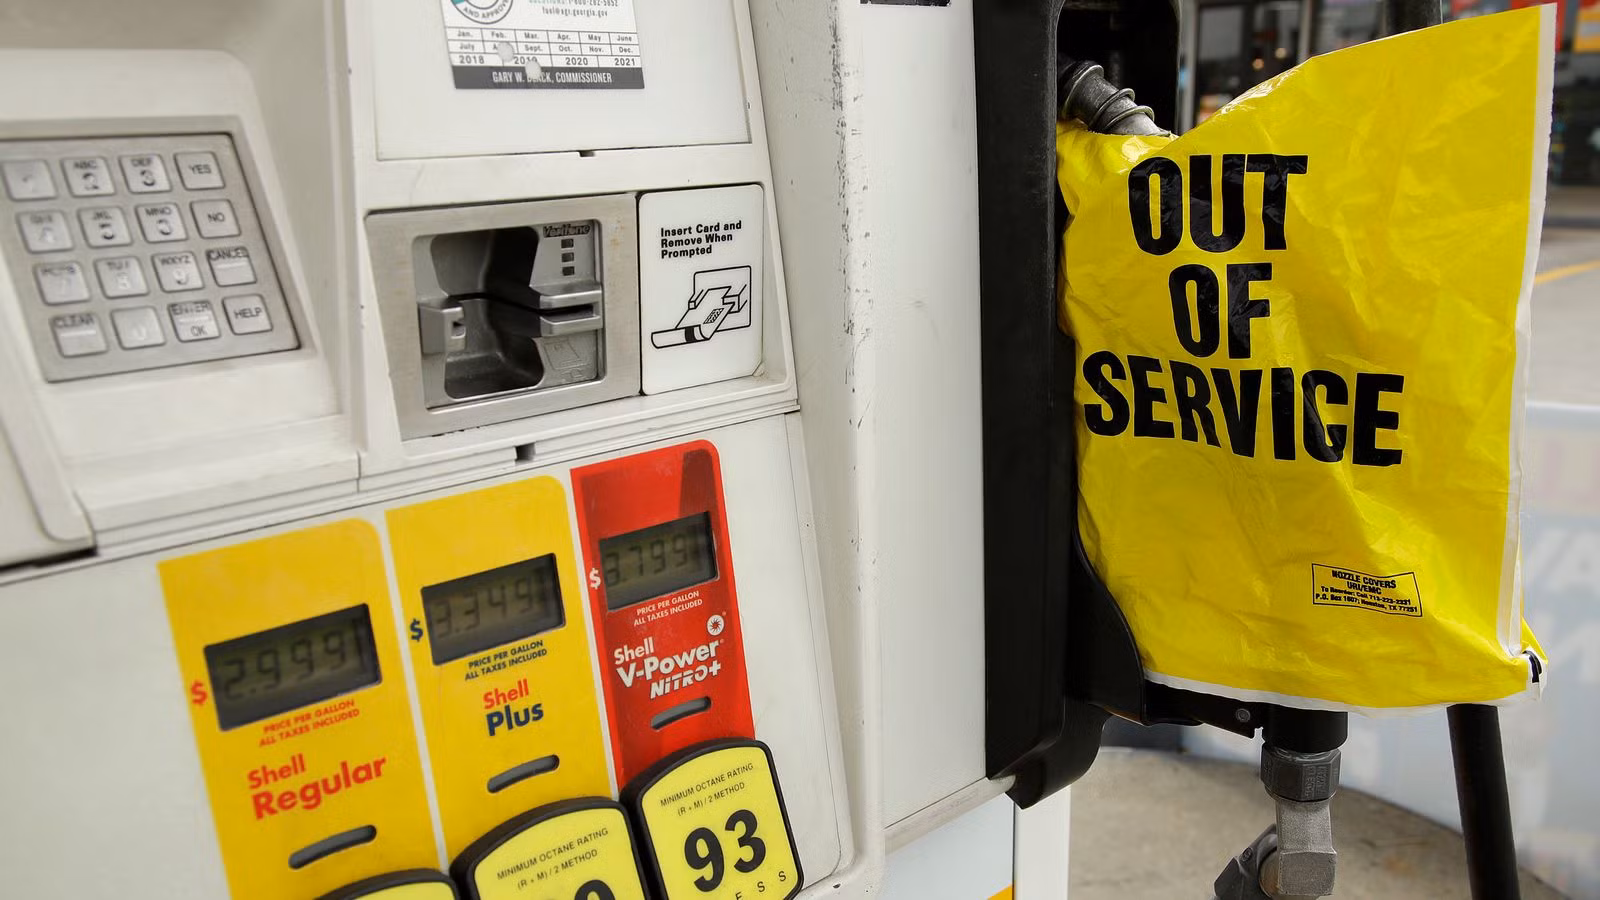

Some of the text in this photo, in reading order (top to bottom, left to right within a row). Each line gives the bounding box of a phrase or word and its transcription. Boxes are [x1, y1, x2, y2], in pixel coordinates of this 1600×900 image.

[460, 43, 475, 51] July
[490, 30, 507, 38] Feb.
[587, 34, 601, 42] May
[458, 54, 485, 65] 2018
[565, 57, 588, 66] 2020
[614, 58, 636, 66] 2021
[492, 71, 513, 83] GARY
[514, 72, 525, 83] W.
[555, 72, 613, 84] COMMISSIONER
[188, 164, 212, 174] YES
[208, 212, 226, 223] NO
[1128, 153, 1309, 256] OUT
[660, 220, 742, 238] Insert Card and
[660, 233, 733, 248] Remove When
[661, 244, 712, 259] Prompted
[234, 306, 262, 318] HELP
[1168, 262, 1273, 360] OF
[190, 326, 208, 337] OK
[1082, 350, 1405, 467] SERVICE
[1332, 570, 1396, 589] NOZZLE COVERS
[634, 598, 702, 627] ALL TAXES INCLUDED
[636, 590, 700, 616] PRICE PER GALLON
[1330, 594, 1342, 602] Box
[464, 648, 548, 680] ALL TAXES INCLUDED
[468, 640, 544, 670] PRICE PER GALLON
[614, 636, 655, 665] Shell
[616, 640, 720, 688] V-Power
[483, 678, 529, 710] Shell
[260, 708, 360, 748] ALL TAXES INCLUDED
[264, 700, 355, 734] PRICE PER GALLON
[486, 703, 544, 736] Plus
[247, 753, 306, 790] Shell
[660, 762, 754, 808] MINIMUM OCTANE RATING
[252, 756, 386, 820] Regular
[678, 806, 686, 816] (R
[693, 800, 704, 810] M)
[708, 795, 714, 803] 2
[714, 782, 746, 800] METHOD
[497, 828, 609, 881] MINIMUM OCTANE RATING
[684, 809, 766, 893] 93
[518, 880, 528, 890] (R
[536, 872, 548, 882] M)
[561, 848, 598, 870] METHOD
